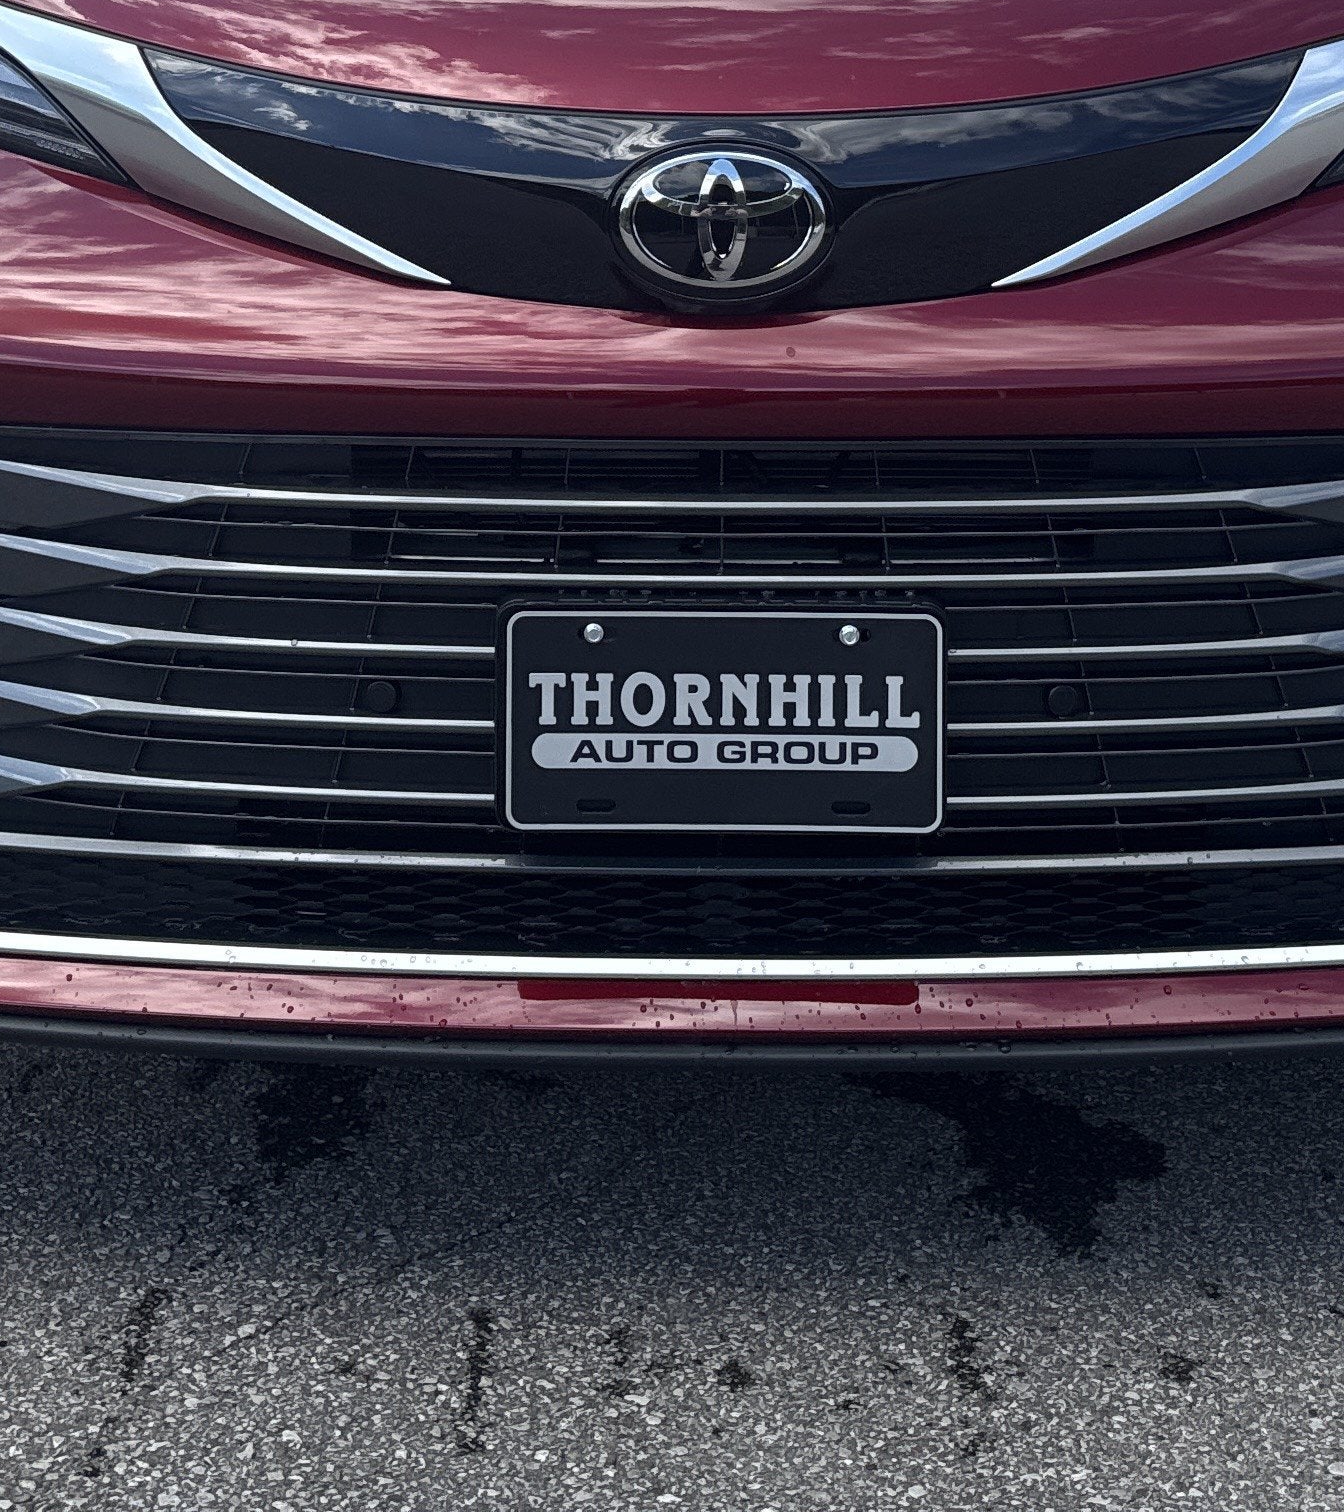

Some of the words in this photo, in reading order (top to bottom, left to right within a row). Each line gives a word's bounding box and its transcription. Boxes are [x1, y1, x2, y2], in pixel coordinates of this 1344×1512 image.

[528, 671, 921, 729] THORNHILL
[569, 739, 699, 764] AUTO
[716, 740, 879, 766] GROUP
